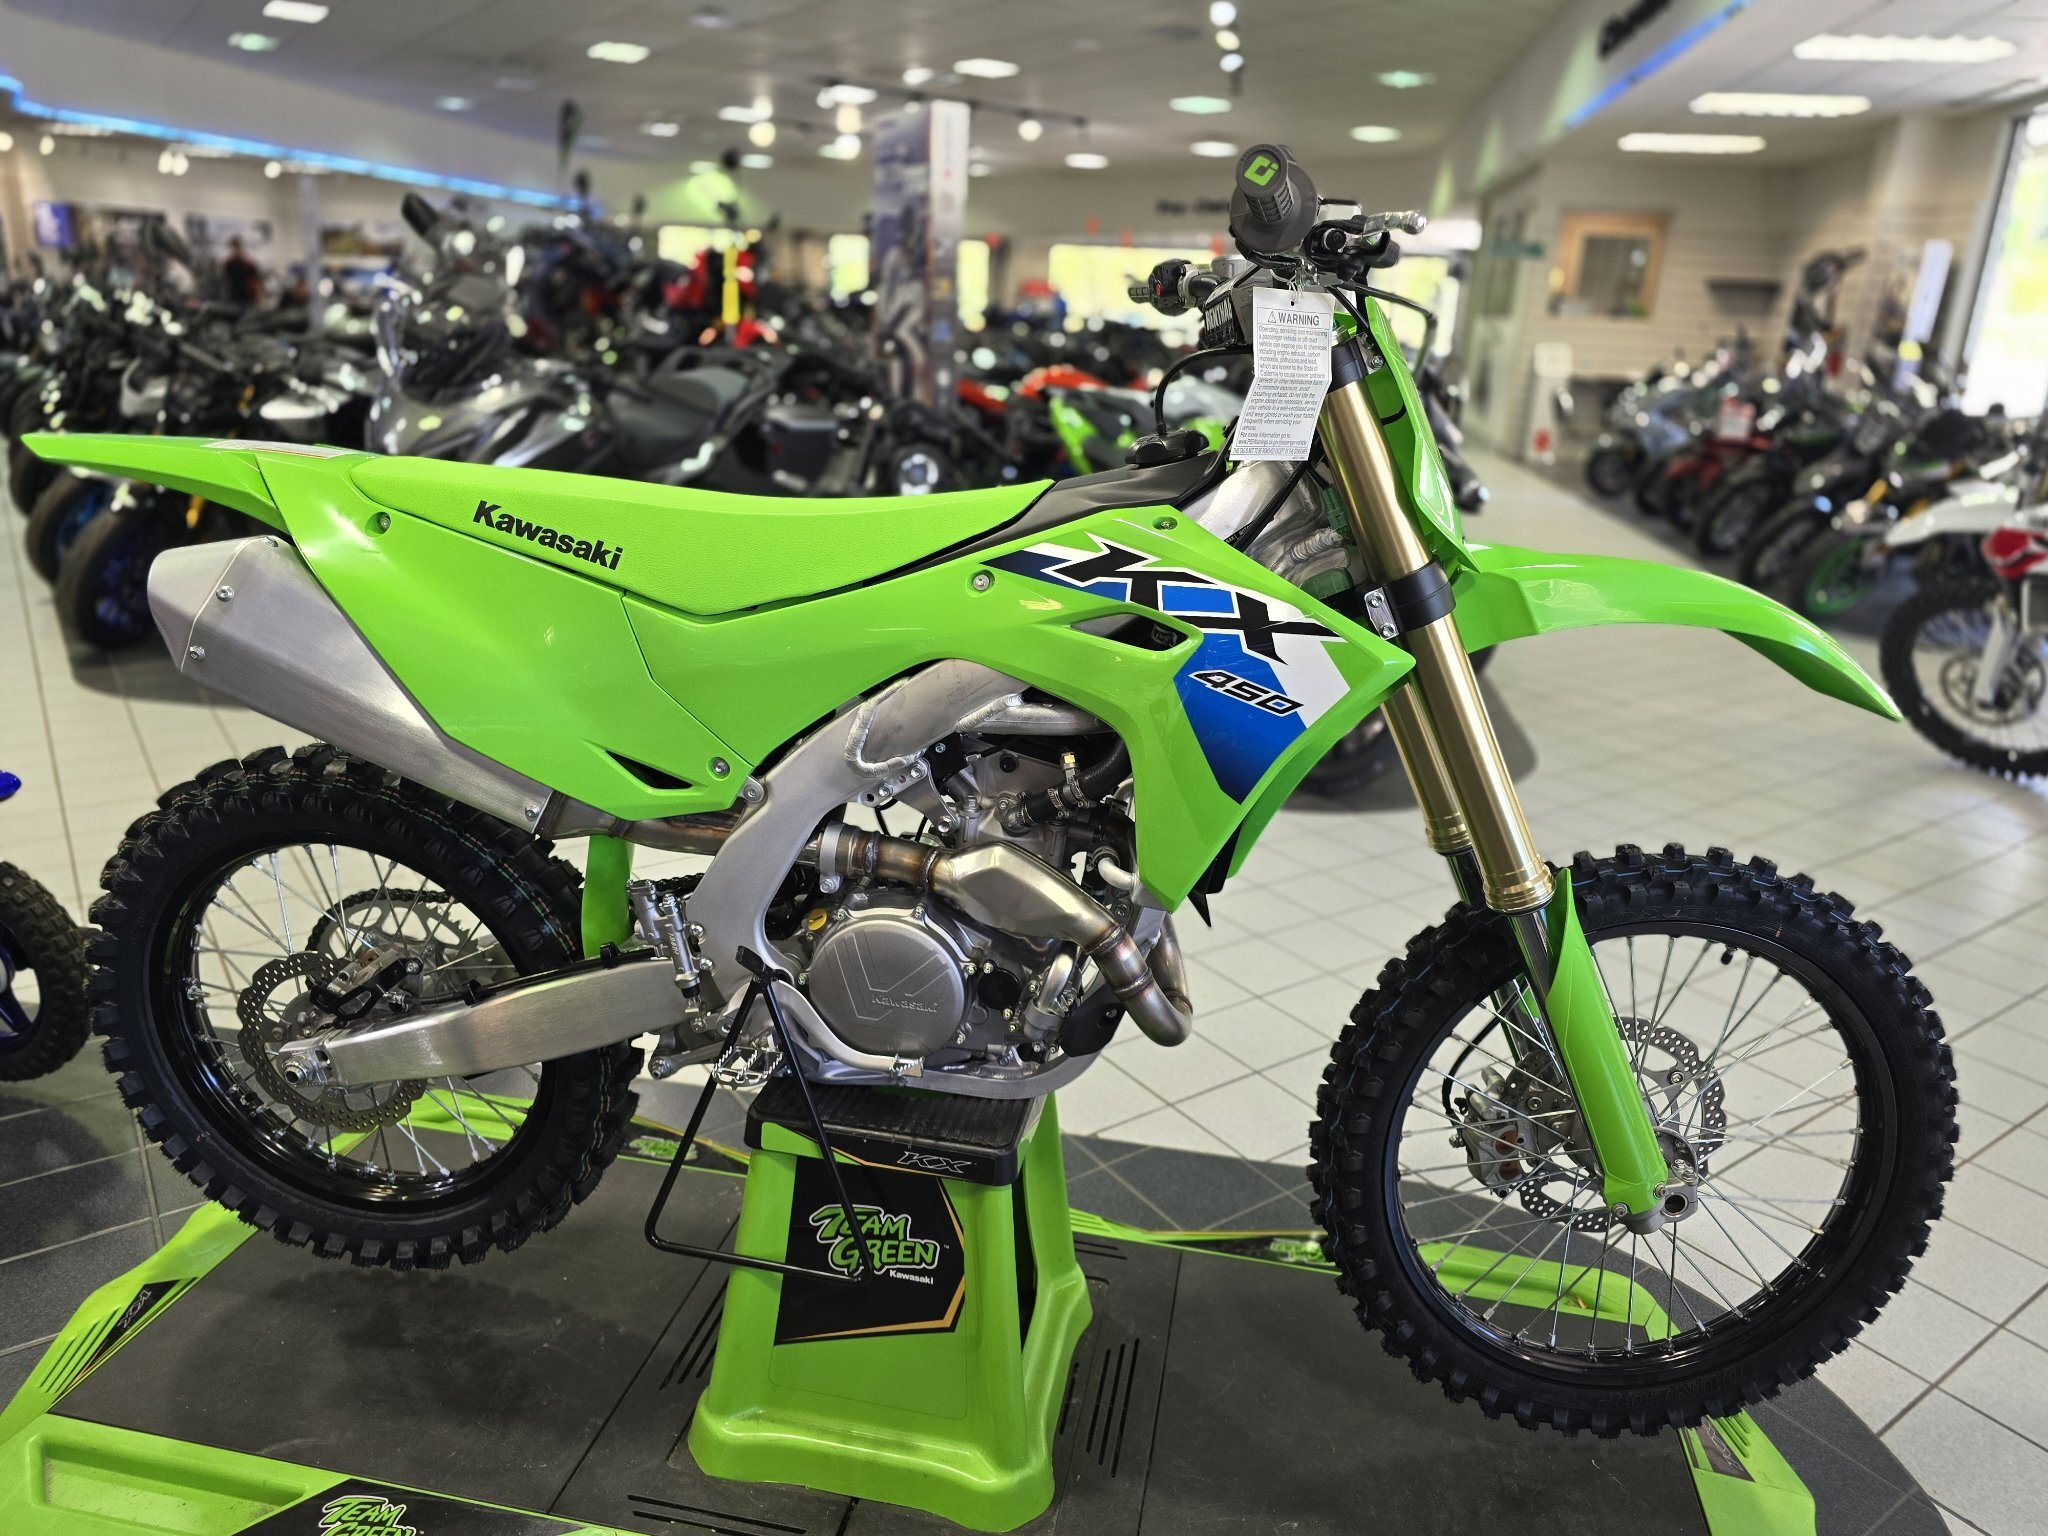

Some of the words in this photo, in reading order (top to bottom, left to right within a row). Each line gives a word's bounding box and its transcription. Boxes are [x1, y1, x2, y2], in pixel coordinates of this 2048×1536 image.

[1278, 312, 1319, 326] WARNING
[473, 500, 623, 570] Kawasaki
[1050, 540, 1349, 666] KX
[1188, 670, 1304, 717] 450
[872, 993, 938, 1013] Kawasaki
[897, 1151, 972, 1173] KX
[810, 1205, 910, 1242] TEAM
[829, 1240, 939, 1276] GREEN
[889, 1269, 934, 1285] Kawasaki
[319, 1496, 405, 1527] TEAM
